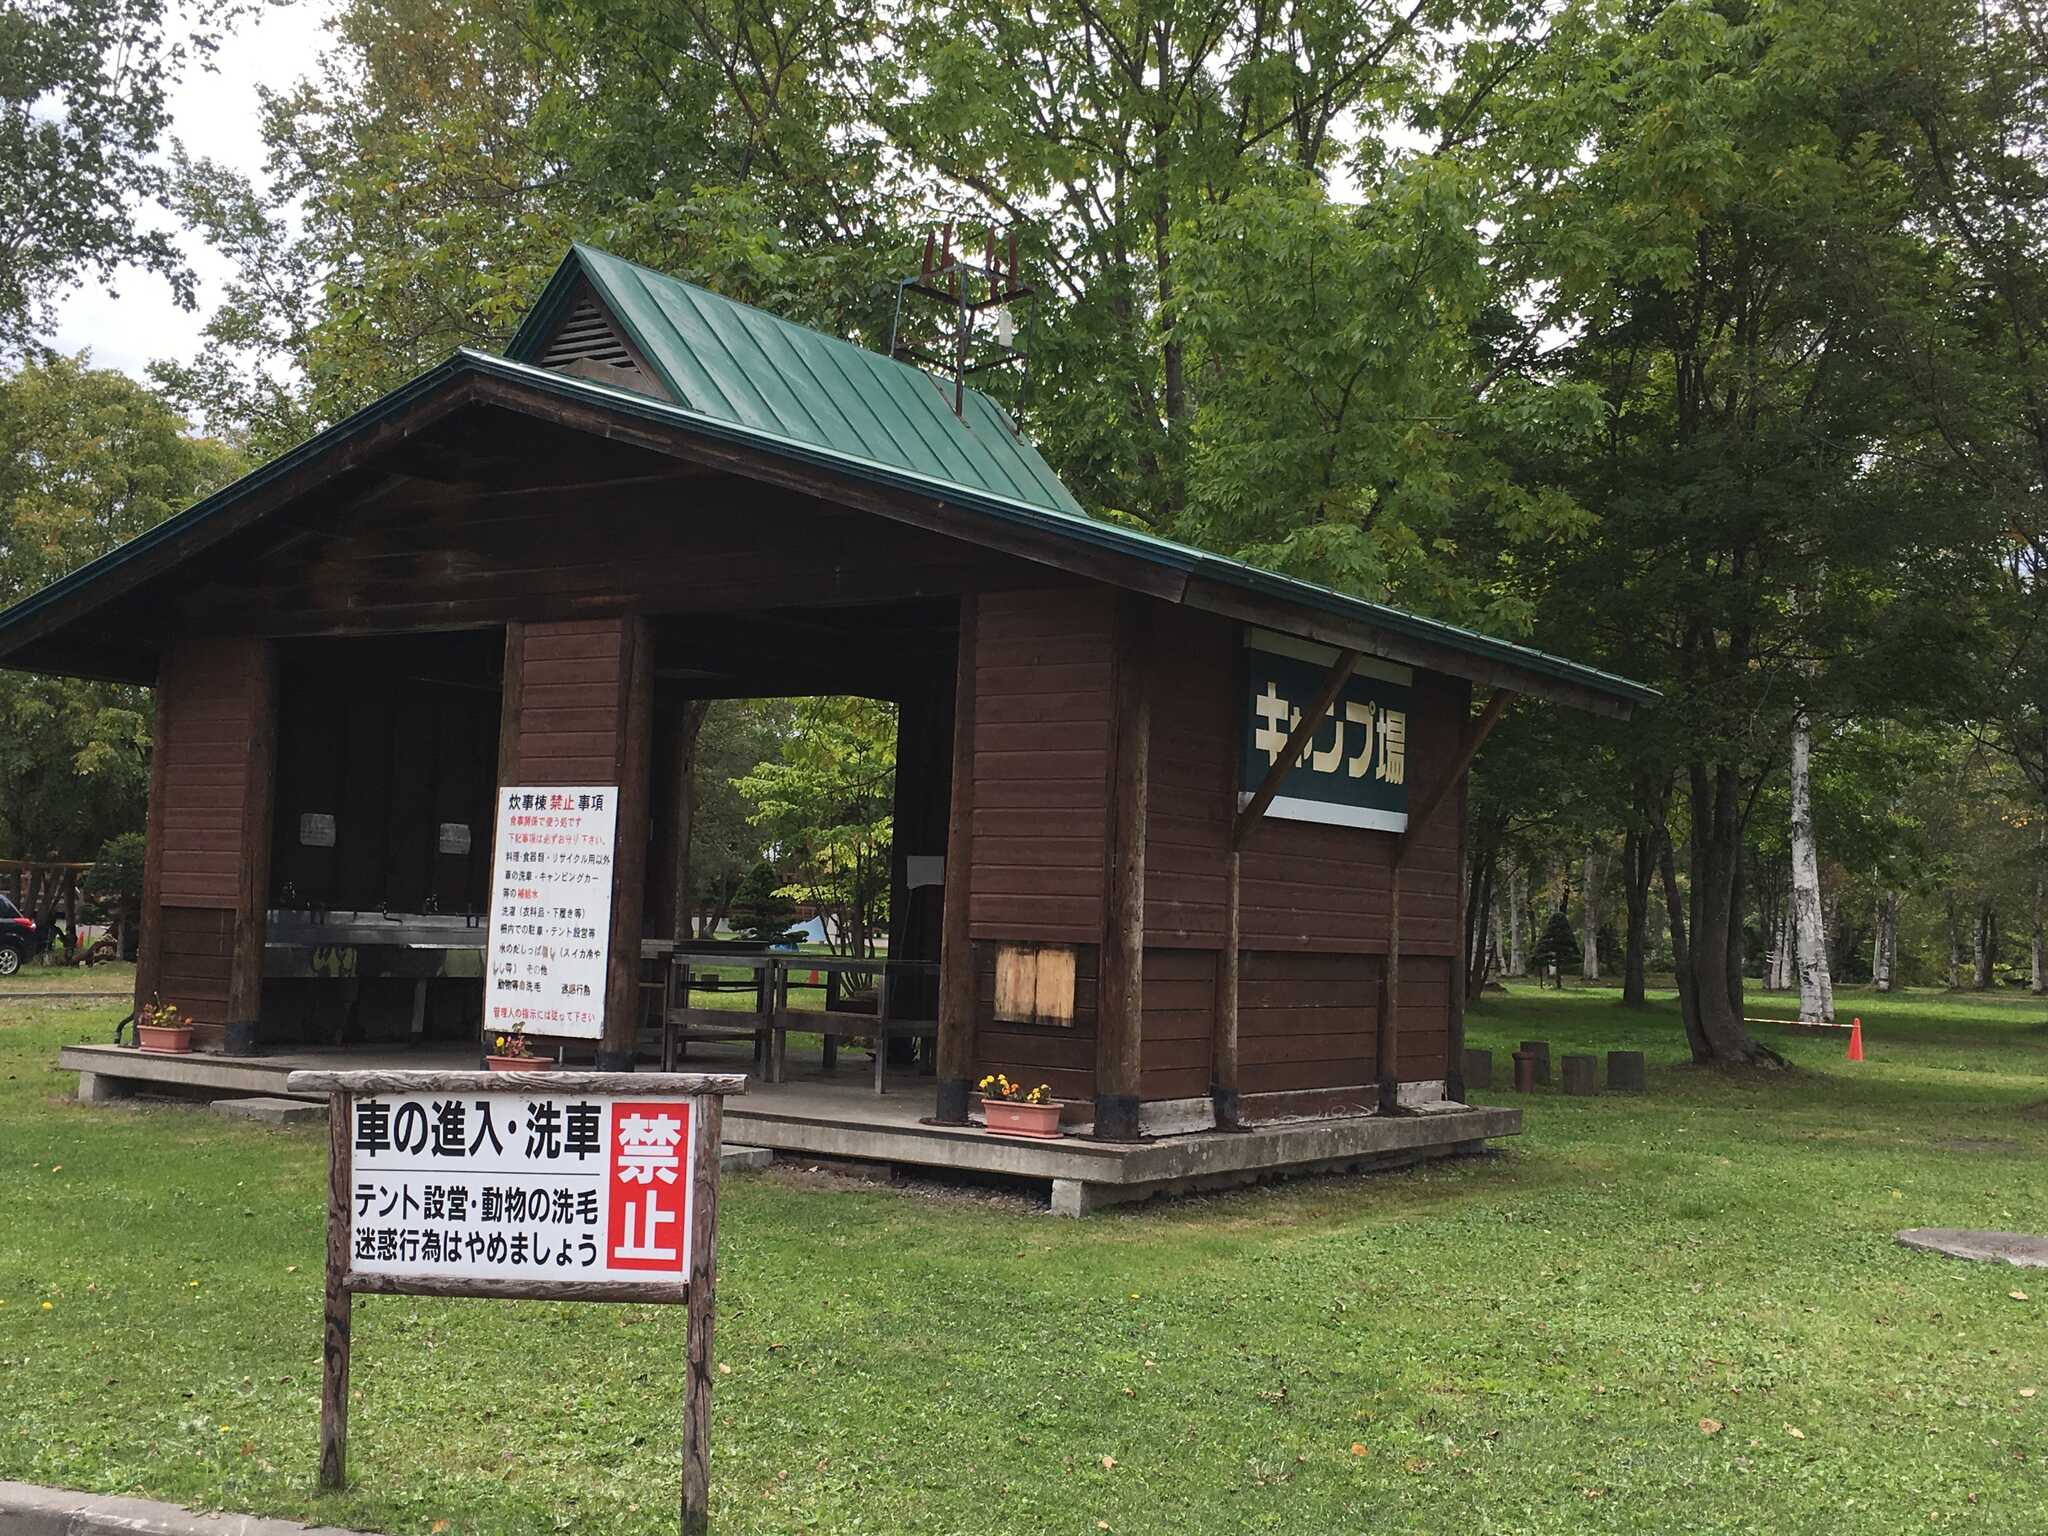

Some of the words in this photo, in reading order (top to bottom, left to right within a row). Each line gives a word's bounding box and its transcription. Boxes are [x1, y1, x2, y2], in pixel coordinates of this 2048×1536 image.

[355, 1099, 602, 1160] 車の進入・洗車
[355, 1183, 599, 1225] テント設営・動物の洗毛
[613, 1113, 682, 1262] 禁止
[355, 1227, 597, 1268] 迷惑行為はやめましょう
